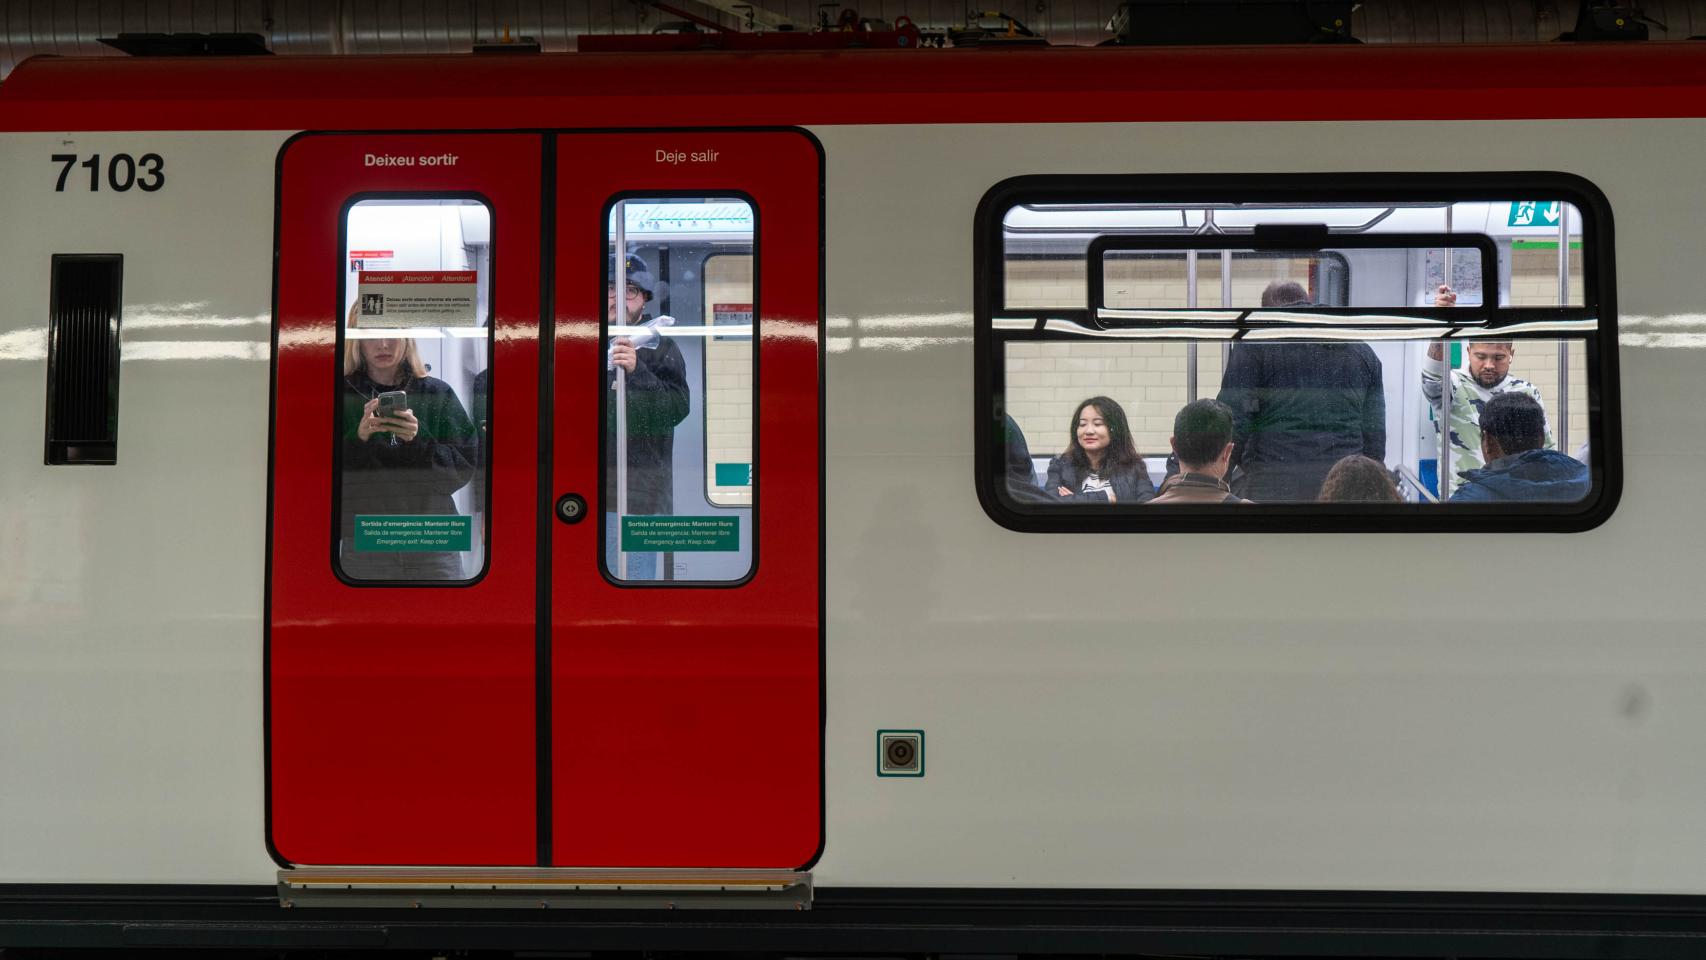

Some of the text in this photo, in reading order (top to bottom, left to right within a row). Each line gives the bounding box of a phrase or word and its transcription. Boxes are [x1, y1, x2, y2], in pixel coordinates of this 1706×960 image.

[364, 153, 459, 166] Deixeu sortir
[655, 149, 720, 165] Deje salir
[51, 153, 165, 193] 7103
[376, 539, 406, 547] Emergency
[643, 539, 674, 547] Emergency
